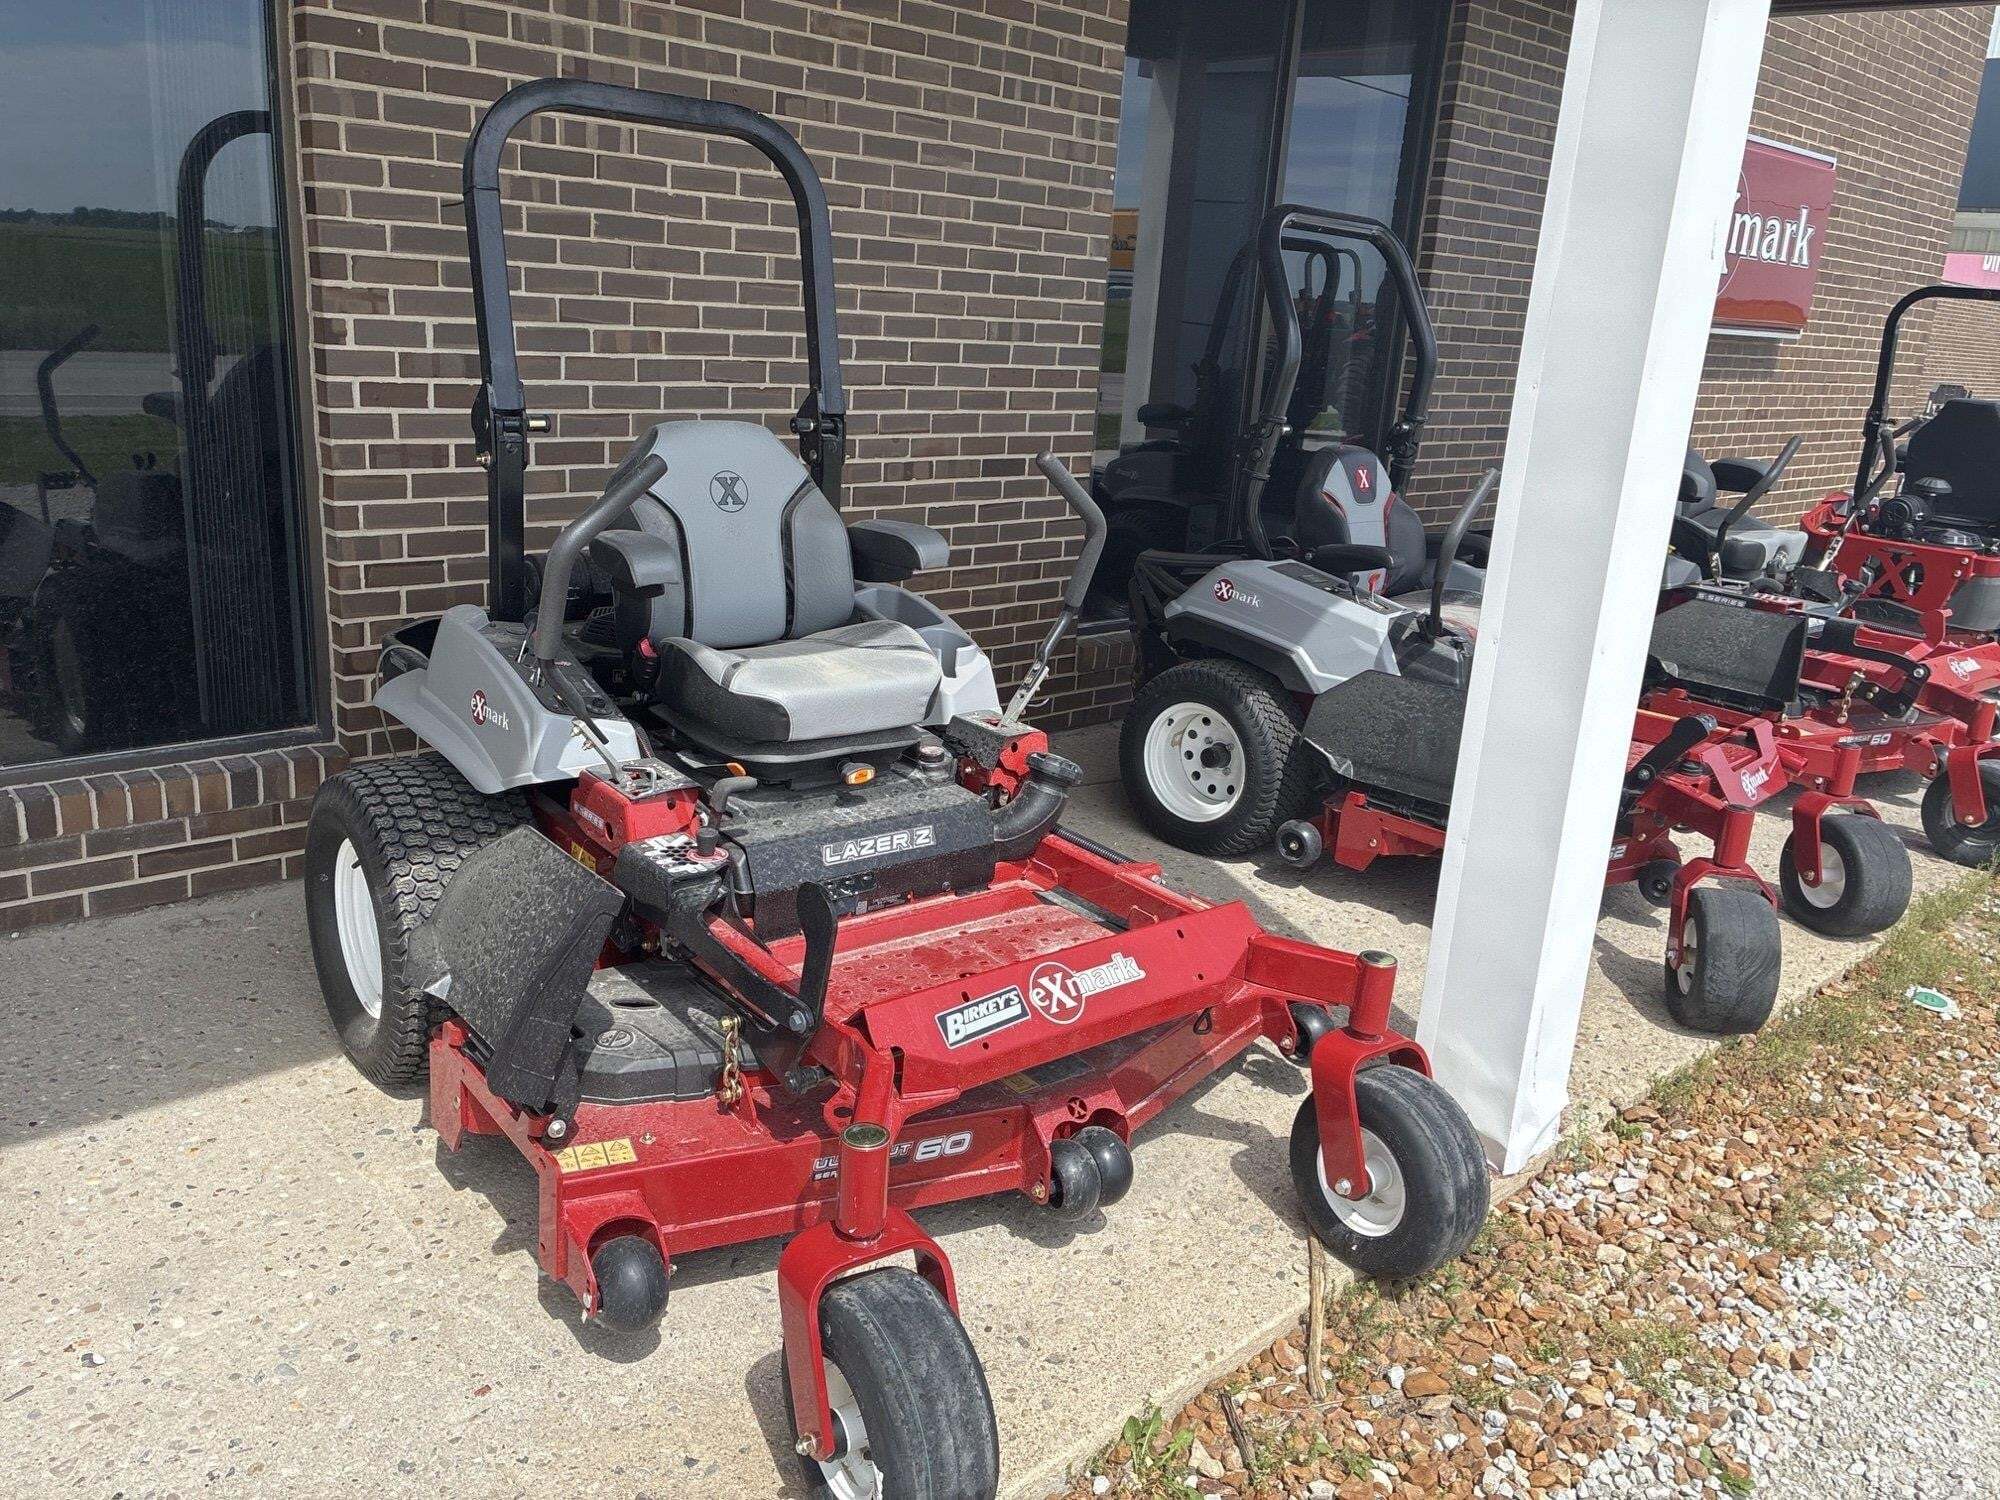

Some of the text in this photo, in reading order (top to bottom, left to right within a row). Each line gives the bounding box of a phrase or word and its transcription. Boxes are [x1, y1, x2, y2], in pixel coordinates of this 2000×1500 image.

[1724, 194, 1816, 271] mark
[1214, 580, 1261, 608] eXmark
[471, 695, 510, 731] eXmark
[1870, 733, 1892, 746] 60
[824, 827, 931, 864] LAZER Z
[1031, 952, 1146, 1015] eXmark
[945, 990, 1021, 1044] BIRKEY'S
[914, 1131, 973, 1162] 60
